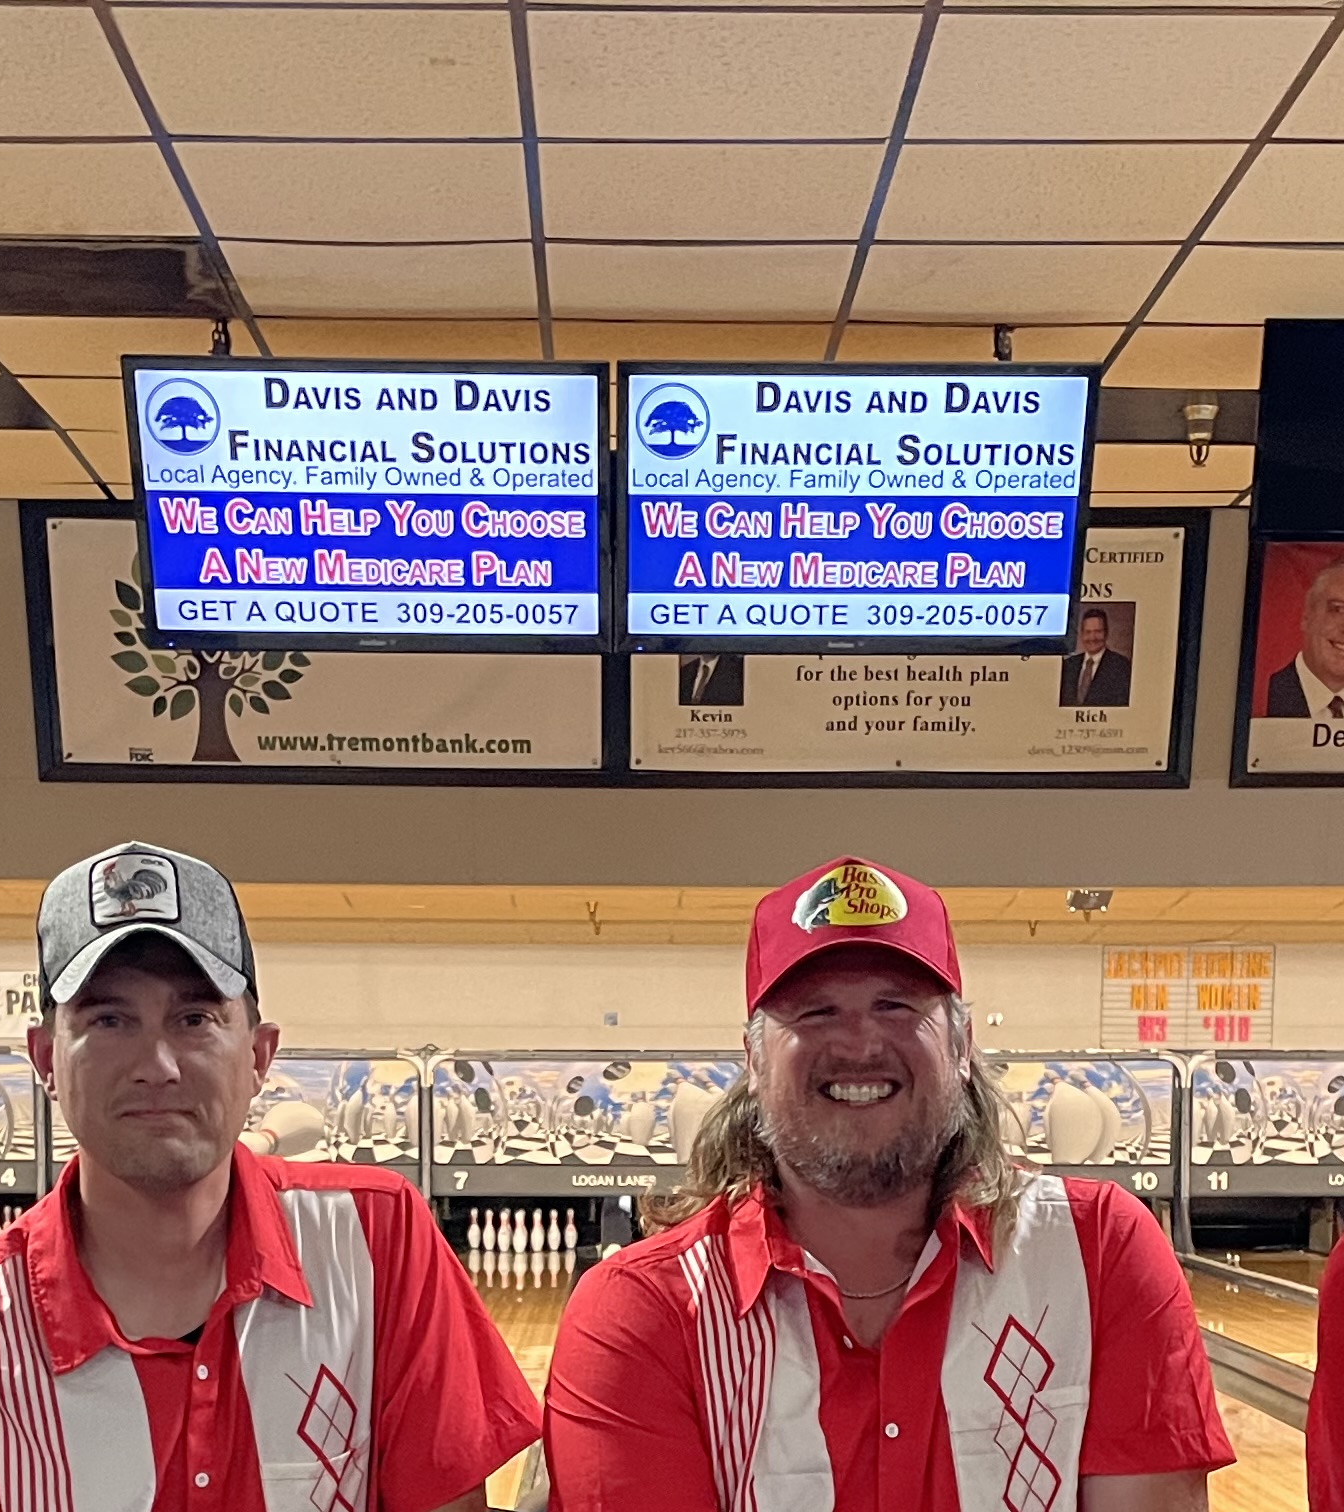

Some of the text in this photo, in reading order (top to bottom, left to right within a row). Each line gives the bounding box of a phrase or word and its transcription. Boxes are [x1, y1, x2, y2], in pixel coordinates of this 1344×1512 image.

[146, 464, 594, 491] Local Agency. Family Owned & Operated
[632, 468, 1076, 493] Local Agency. Family Owned & Operated
[199, 547, 232, 584] A
[178, 600, 579, 625] GET A QUOTE 309-205-0057
[651, 603, 1049, 627] GET A QUOTE 309-205-0057
[796, 665, 1009, 687] for the best health plan
[832, 690, 971, 712] options for you
[690, 709, 733, 723] Kevin
[826, 715, 976, 737] and your family.
[1075, 710, 1108, 723] Rich
[257, 733, 532, 754] www.tremontbank.com
[844, 883, 878, 899] Pro
[843, 899, 899, 920] Shops
[0, 1167, 17, 1187] 4
[453, 1171, 469, 1191] 7
[572, 1174, 656, 1187] LOGAN LANES
[1131, 1171, 1158, 1190] 10
[1207, 1171, 1229, 1190] 11
